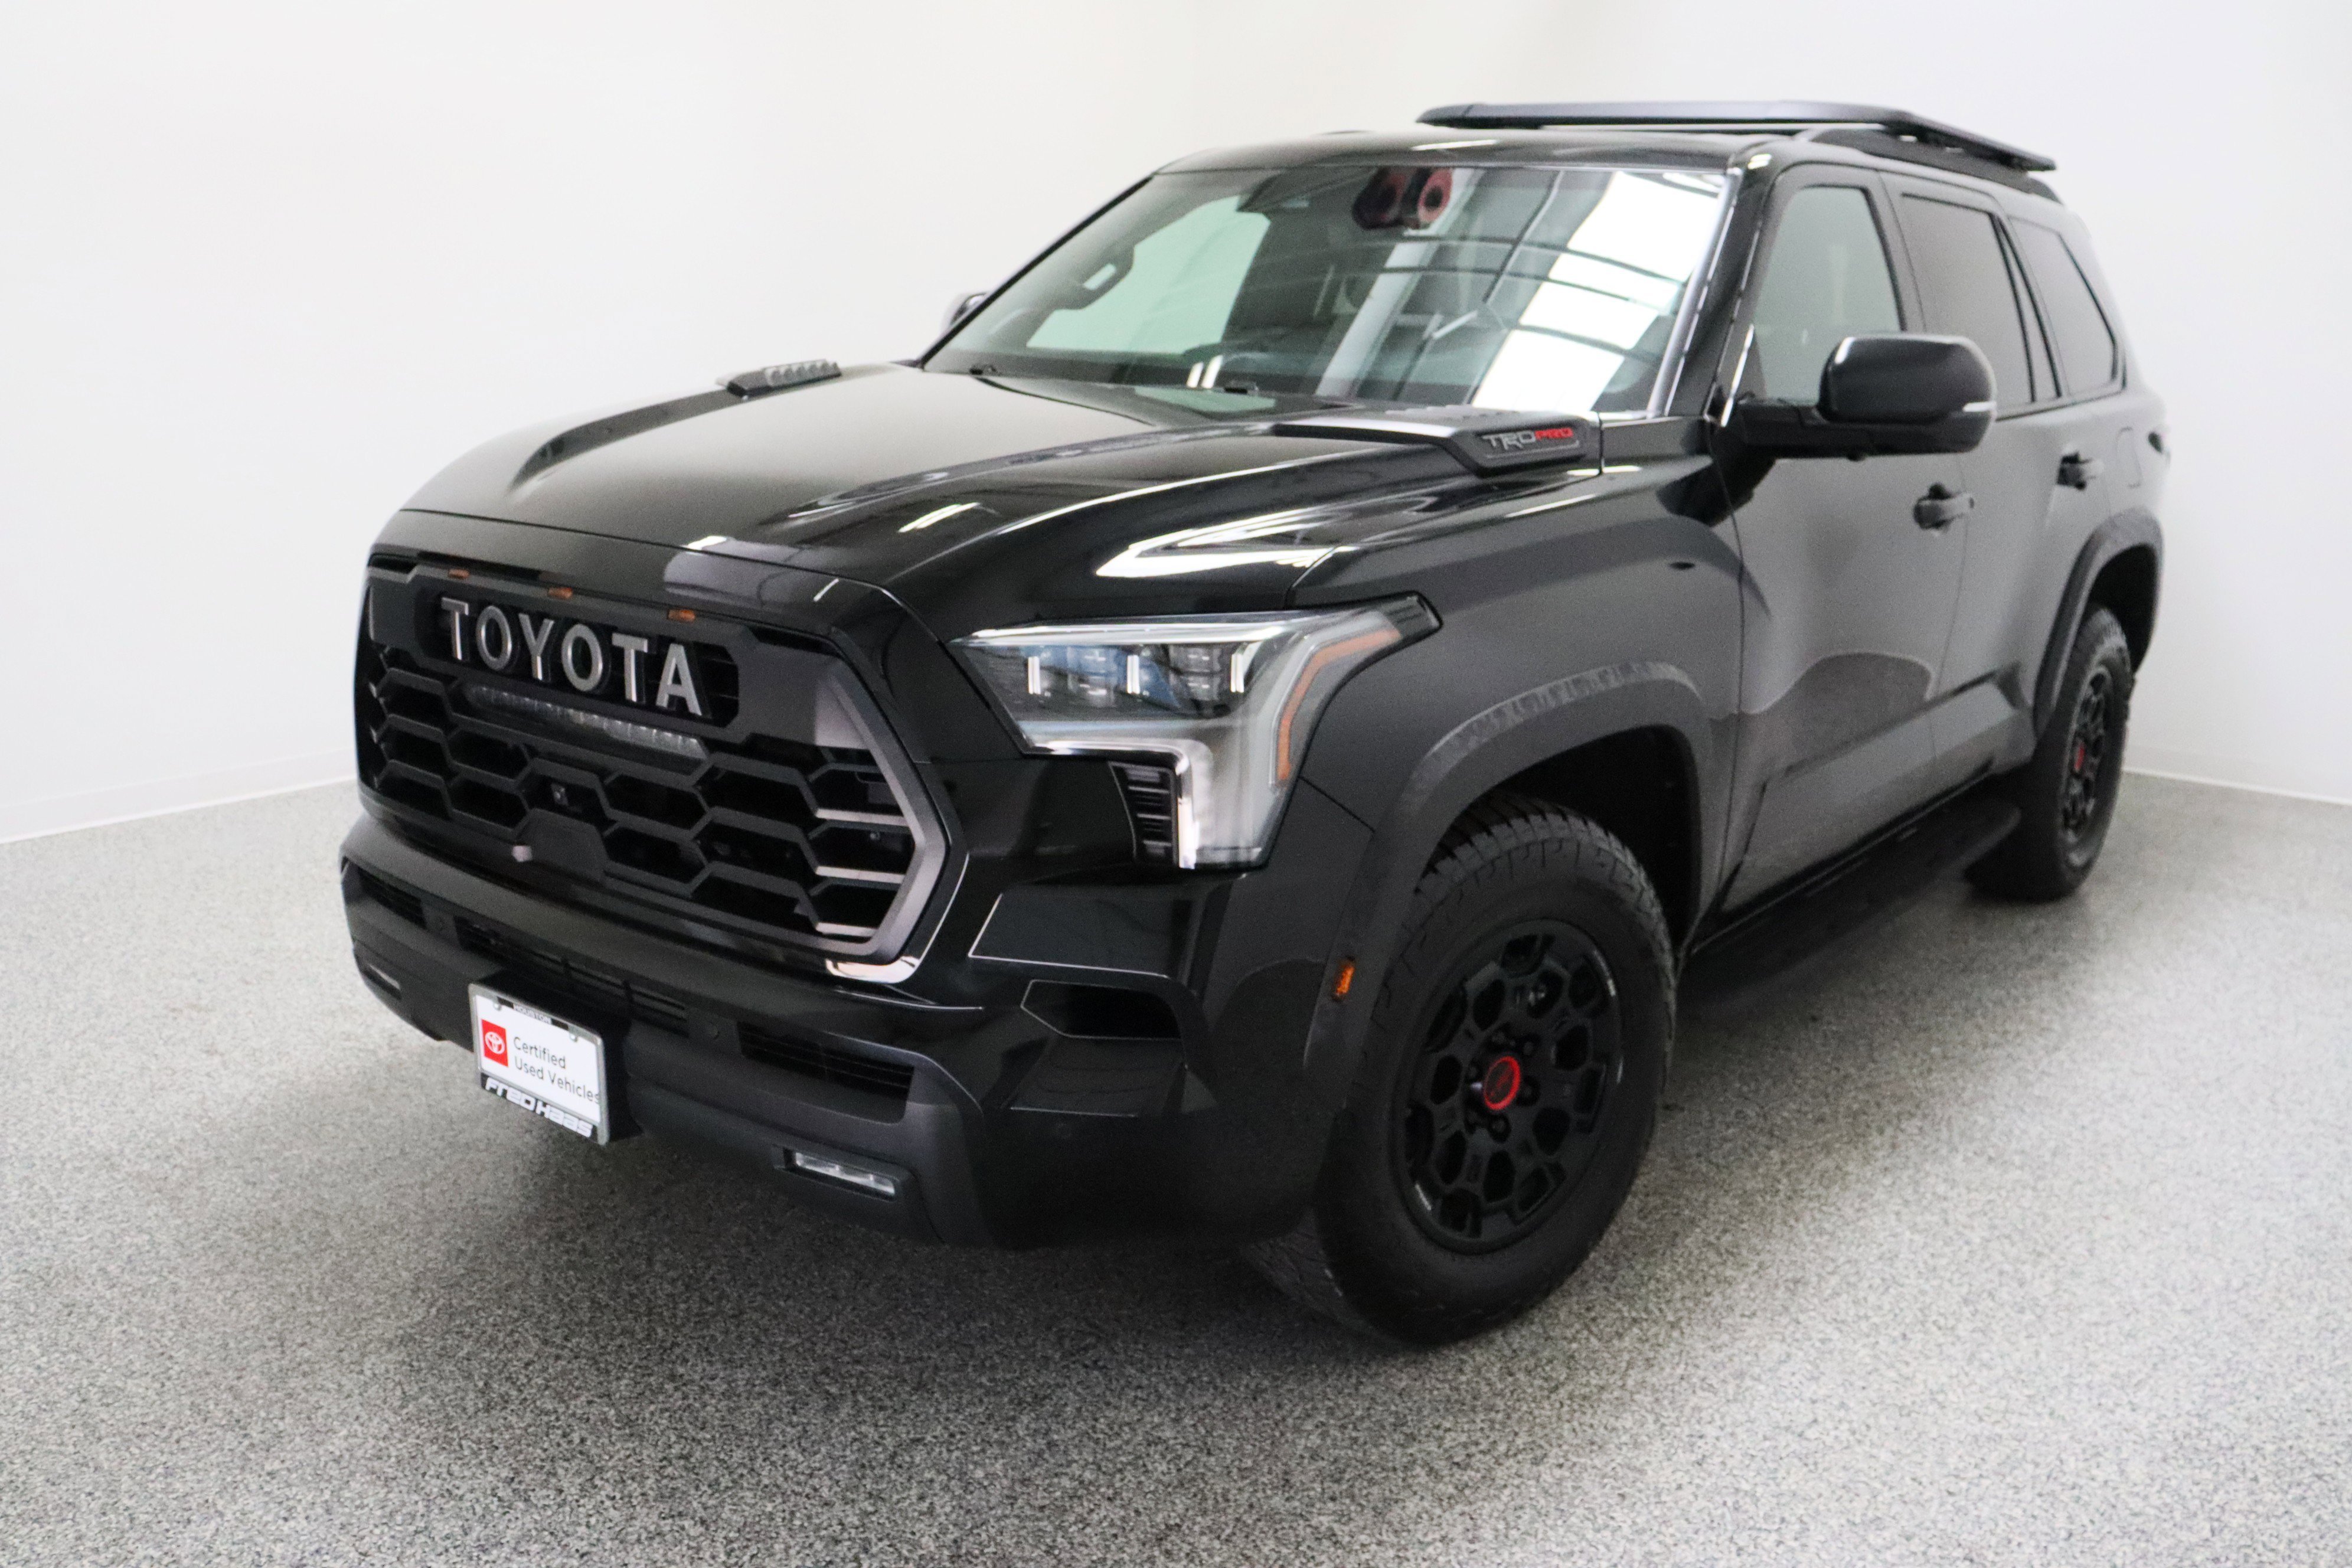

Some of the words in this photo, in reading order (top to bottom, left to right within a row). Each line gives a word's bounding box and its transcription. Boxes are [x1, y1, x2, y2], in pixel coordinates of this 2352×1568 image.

[440, 596, 703, 717] TOYOTA
[514, 1036, 566, 1069] Certified
[514, 1055, 544, 1080] Used
[547, 1070, 600, 1105] Vehicles
